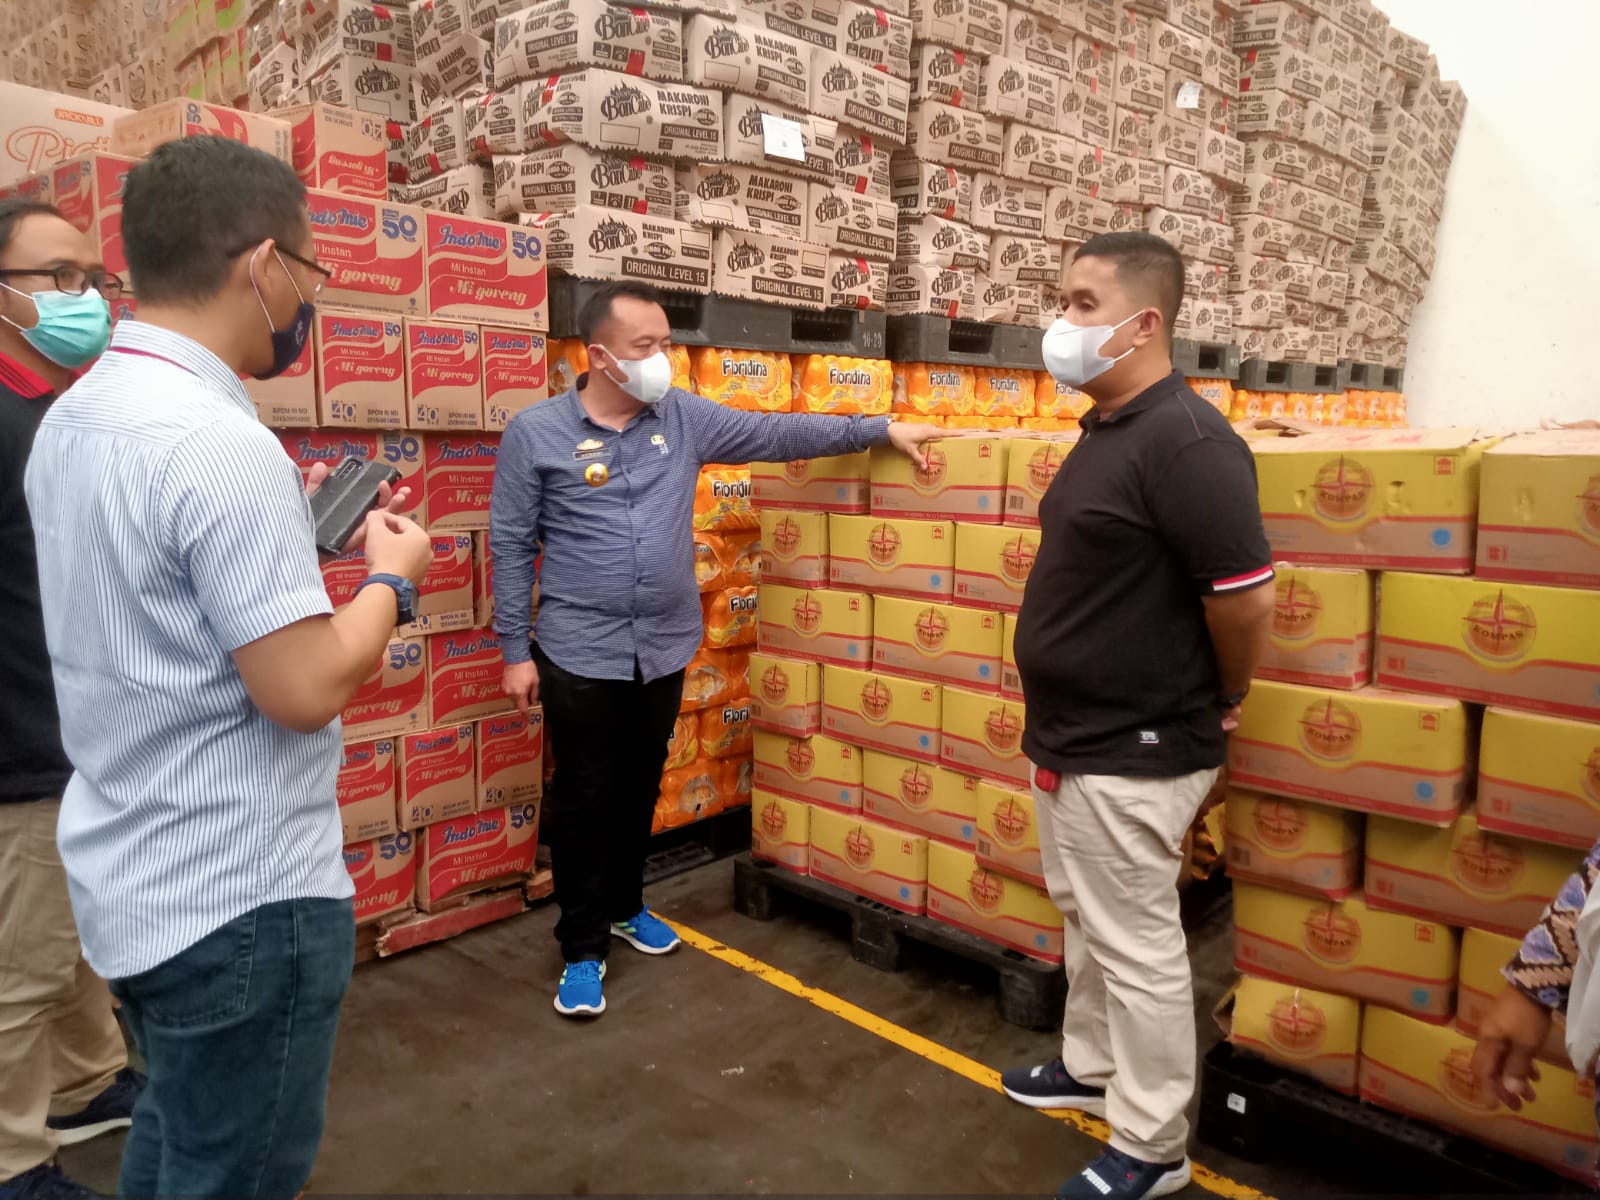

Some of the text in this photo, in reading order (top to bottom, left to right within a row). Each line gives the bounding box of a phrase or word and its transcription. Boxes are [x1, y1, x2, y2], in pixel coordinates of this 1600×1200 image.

[768, 16, 798, 37] ORIGINAL
[801, 29, 822, 45] LEVEL
[754, 34, 798, 56] MAKARONI
[756, 47, 783, 63] KRISPI
[657, 90, 709, 106] MAKARONI
[660, 102, 691, 118] KRISPI
[848, 102, 875, 123] ORIGINAL
[876, 112, 897, 131] LEVEL
[663, 126, 691, 138] ORIGINAL
[692, 129, 708, 139] LEVEL
[520, 161, 545, 176] KRISPI
[546, 182, 565, 194] LEVEL
[750, 174, 793, 193] MAKARONI
[747, 187, 775, 203] KRISPI
[382, 214, 417, 240] 50
[642, 222, 675, 235] MAKARONI
[642, 231, 663, 241] KRISPI
[839, 229, 868, 244] ORIGINAL
[869, 236, 886, 249] LEVEL
[321, 244, 352, 257] Instan
[512, 235, 542, 260] 50
[462, 264, 487, 276] Instan
[626, 259, 667, 277] ORIGINAL
[669, 269, 695, 282] LEVEL
[341, 265, 402, 292] goreng
[456, 280, 528, 305] Mi goreng
[755, 279, 790, 294] ORIGINAL
[791, 285, 812, 299] LEVEL
[384, 323, 401, 337] 50
[463, 333, 478, 344] 50
[532, 338, 544, 349] 50
[350, 348, 369, 357] Instan
[356, 363, 396, 377] goreng
[722, 358, 769, 378] Floridina
[440, 370, 474, 382] goreng
[510, 373, 540, 385] goreng
[829, 367, 872, 386] Floridina
[384, 437, 419, 463] 50
[460, 474, 485, 484] Instan
[455, 489, 473, 503] Mi
[456, 536, 471, 549] 50
[432, 575, 466, 587] goreng
[389, 642, 422, 671] 50
[466, 669, 489, 680] Instan
[342, 698, 402, 722] goreng
[723, 705, 750, 727] Flori
[459, 727, 472, 739] 50
[376, 742, 393, 755] 50
[436, 764, 467, 778] goreng
[350, 781, 386, 794] goreng
[510, 803, 536, 829] 50
[379, 831, 413, 860] 50
[465, 851, 488, 864] Instan
[459, 857, 526, 884] Mi goreng
